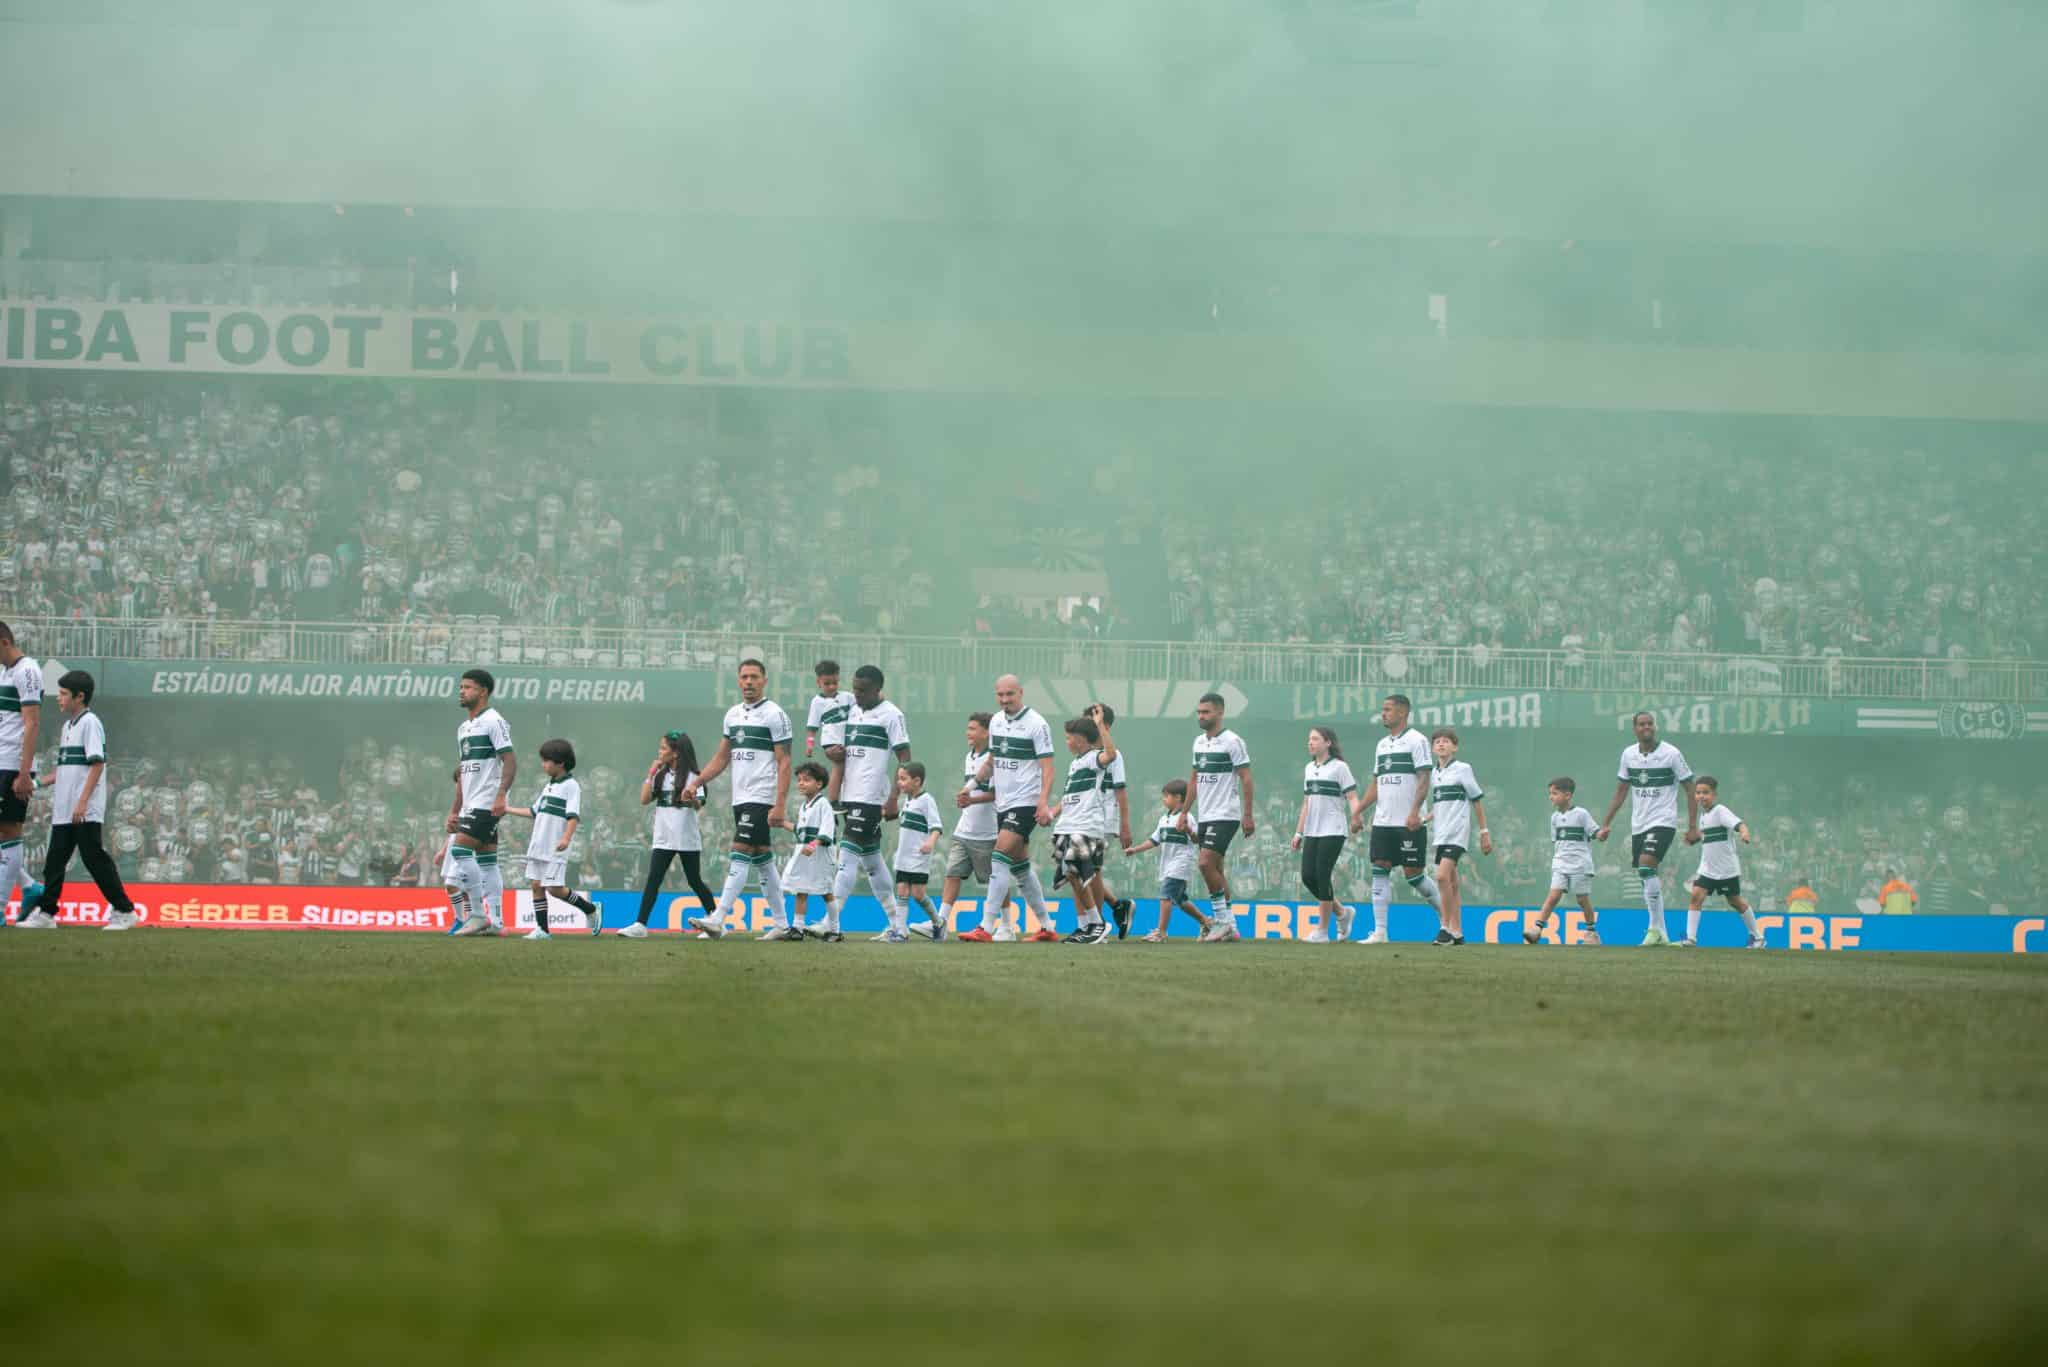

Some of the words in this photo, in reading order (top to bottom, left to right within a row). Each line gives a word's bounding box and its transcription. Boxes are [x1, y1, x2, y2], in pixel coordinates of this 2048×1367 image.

[168, 311, 382, 368] FOOT
[412, 317, 611, 374] BALL
[640, 322, 849, 381] CLUB
[152, 666, 252, 694] ESTÁDIO
[258, 673, 342, 696] MAJOR
[348, 669, 453, 697] ANTÔNIO
[546, 679, 645, 702] PEREIRA
[1960, 709, 2005, 731] CFC
[160, 898, 260, 922] SÉRIE
[268, 905, 289, 922] B
